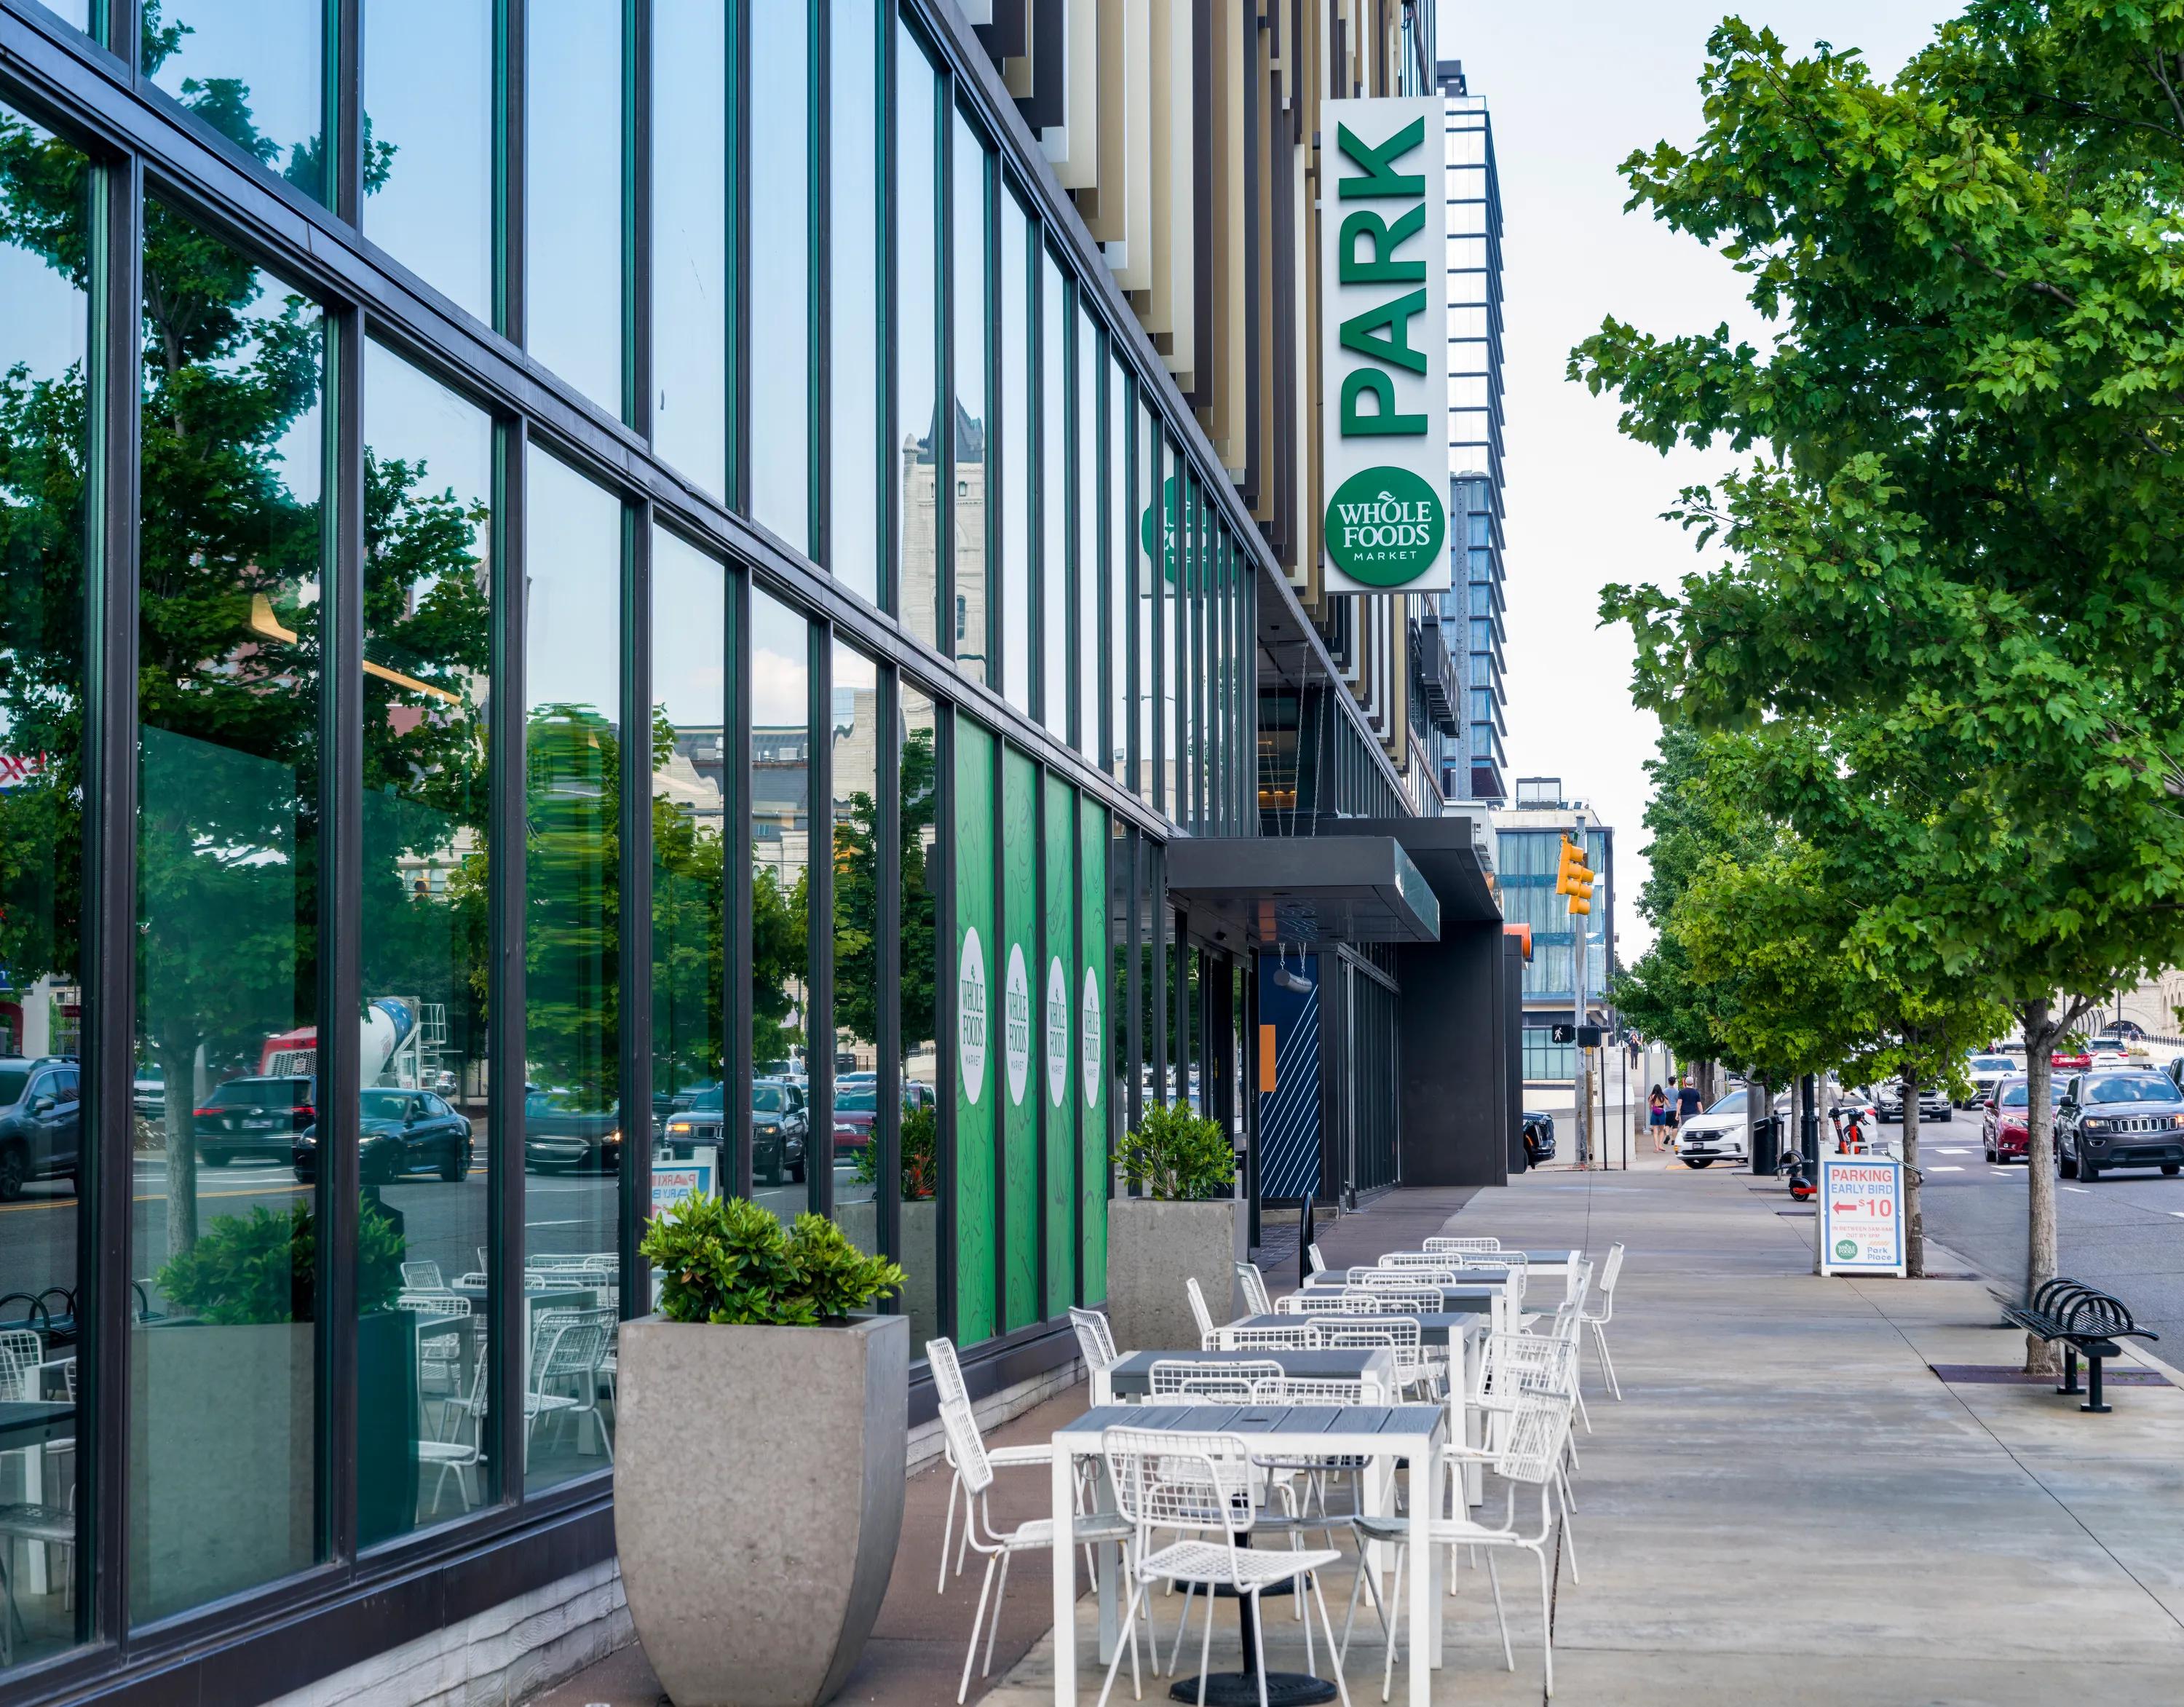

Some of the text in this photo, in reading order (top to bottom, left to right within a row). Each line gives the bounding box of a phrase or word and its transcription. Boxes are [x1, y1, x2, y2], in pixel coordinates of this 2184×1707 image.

[1338, 115, 1428, 437] PARK
[1337, 501, 1432, 525] WHOLE
[1343, 524, 1431, 548] FOODS
[1353, 551, 1417, 561] MARKET
[962, 979, 983, 1013] WHOLE
[1008, 991, 1026, 1022] WHOLE
[1048, 1001, 1065, 1029] WHOLE
[1084, 1009, 1098, 1034] WHOLE
[963, 1015, 983, 1047] FOODS
[1009, 1023, 1026, 1053] FOODS
[1050, 1031, 1065, 1058] FOODS
[1085, 1037, 1098, 1062] FOODS
[1832, 1169, 1891, 1182] PARKING
[1831, 1184, 1893, 1195] EARLY BIRD
[1858, 1199, 1891, 1217] $10
